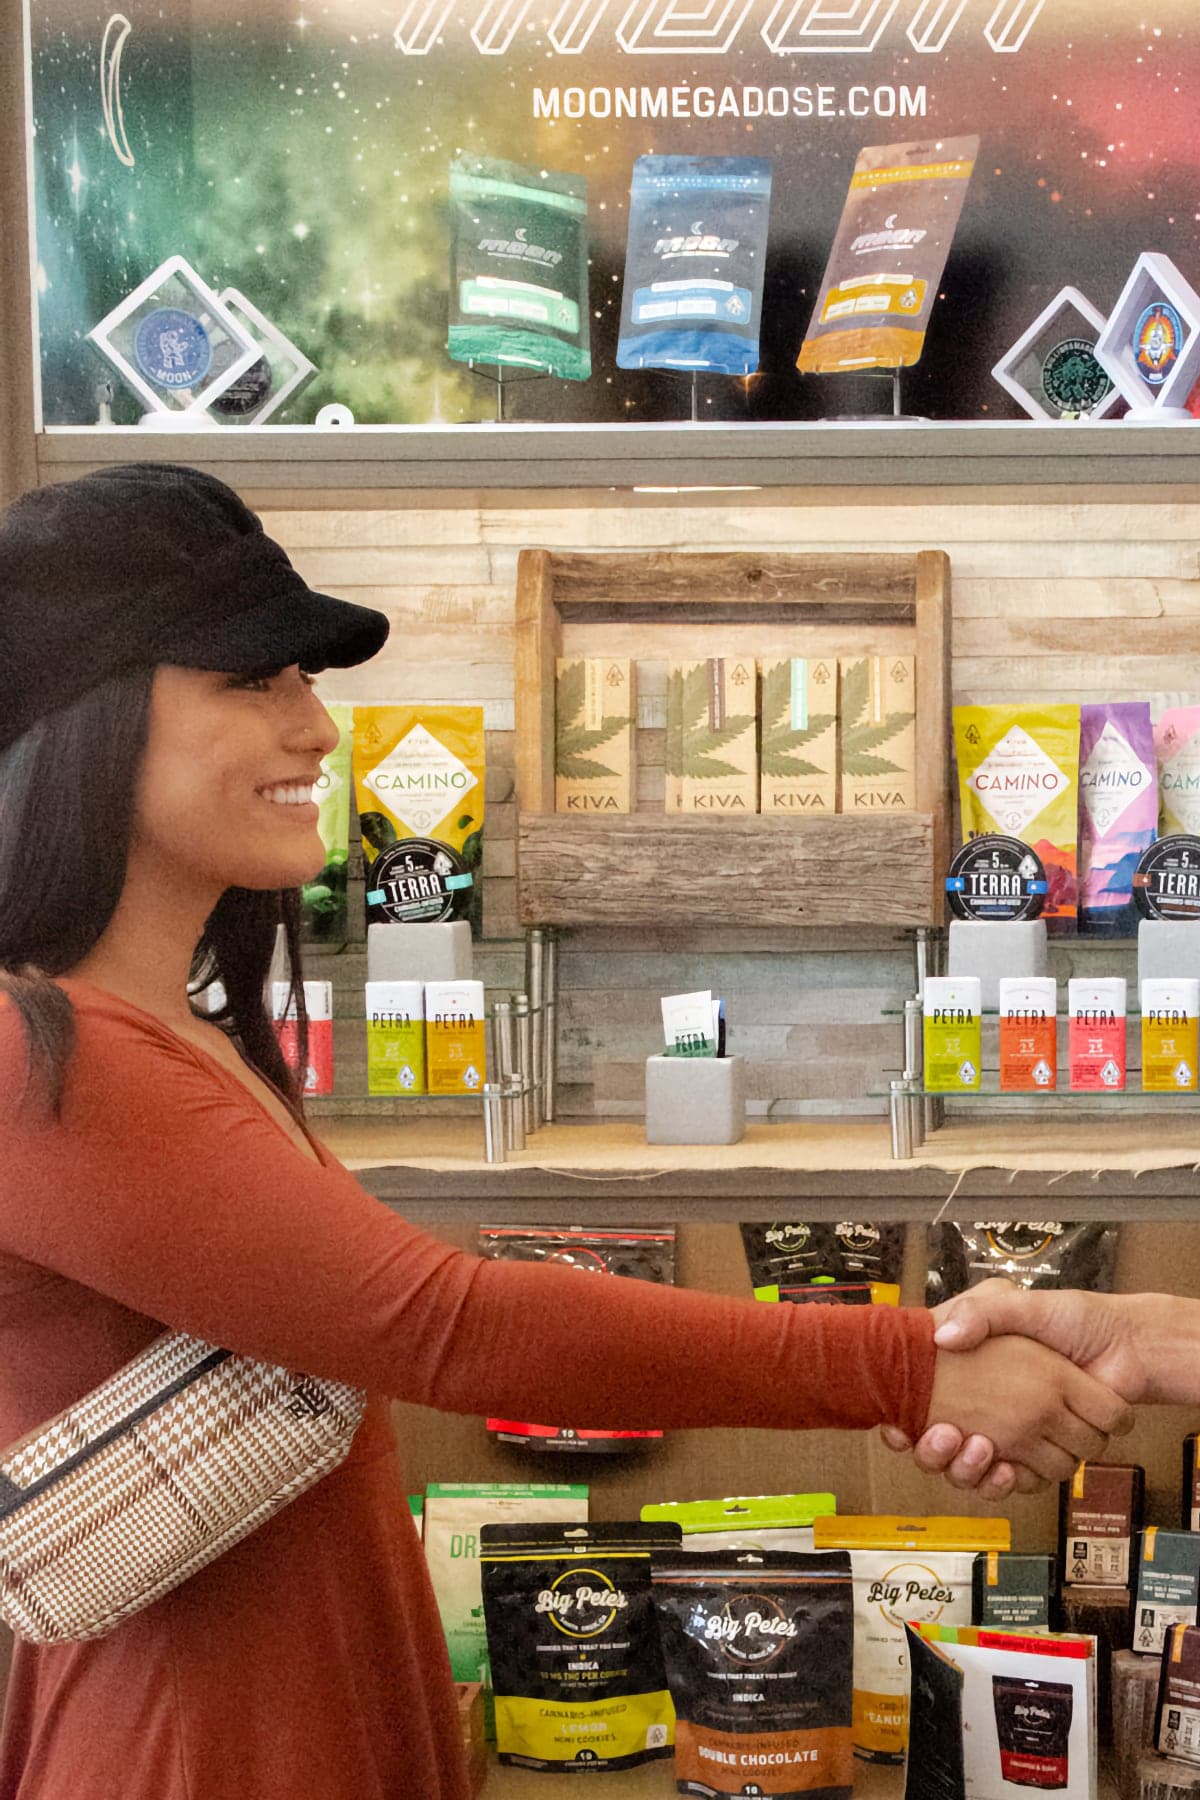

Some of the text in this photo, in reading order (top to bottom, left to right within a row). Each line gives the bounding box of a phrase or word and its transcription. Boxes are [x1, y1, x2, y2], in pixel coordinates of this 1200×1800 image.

[532, 86, 928, 118] MOONMEGADOSE.COM
[375, 772, 467, 790] CAMINO
[975, 773, 1059, 791] CAMINO
[1081, 770, 1143, 787] CAMINO
[567, 795, 619, 810] KIVA
[693, 795, 745, 809] KIVA
[773, 794, 825, 808] KIVA
[853, 793, 906, 807] KIVA
[405, 855, 413, 872] 5
[992, 851, 1000, 868] 5
[1181, 851, 1189, 869] 5
[388, 873, 442, 903] TERRA
[970, 874, 1021, 896] TERRA
[372, 1012, 411, 1029] PETRA
[434, 1013, 475, 1030] PETRA
[933, 1008, 973, 1025] PETRA
[1007, 1009, 1047, 1026] PETRA
[1076, 1009, 1117, 1026] PETRA
[1149, 1009, 1188, 1026] PETRA
[535, 1586, 629, 1615] Big Pete's
[868, 1581, 955, 1606] Big Pete's
[705, 1612, 798, 1640] Big Pete's
[740, 1750, 818, 1766] CHOCOLATE
[746, 1786, 757, 1794] 10
